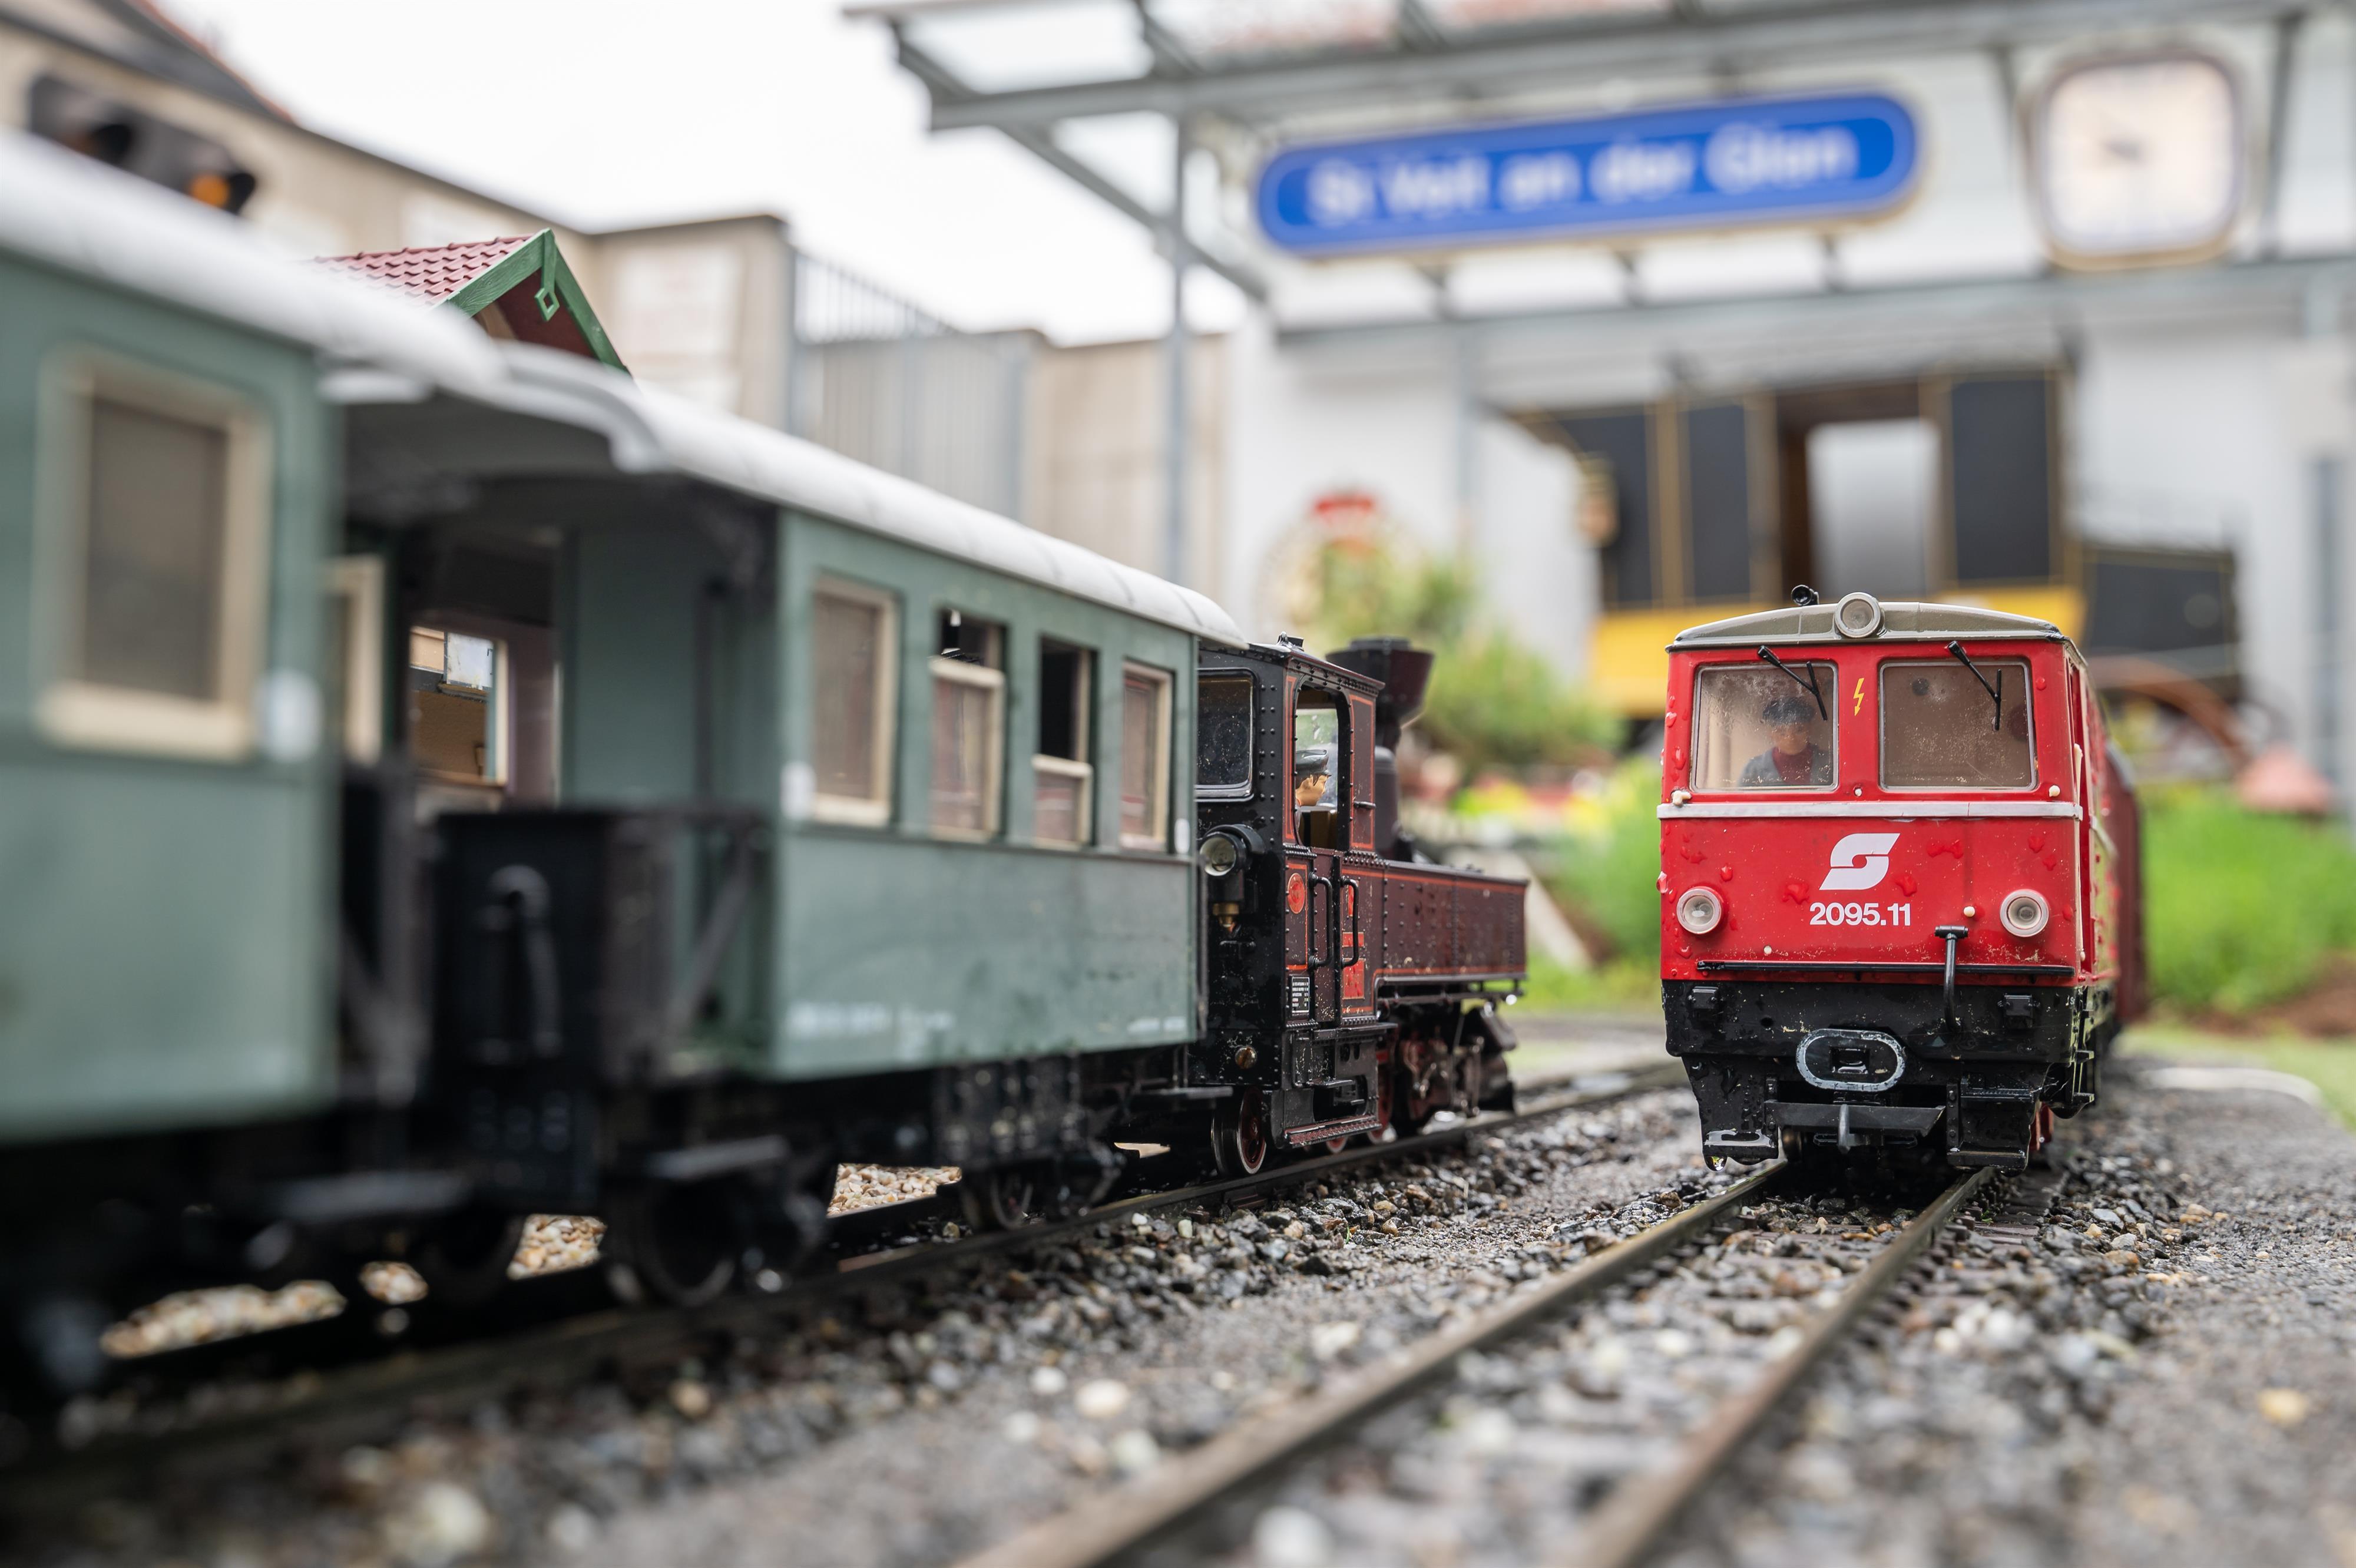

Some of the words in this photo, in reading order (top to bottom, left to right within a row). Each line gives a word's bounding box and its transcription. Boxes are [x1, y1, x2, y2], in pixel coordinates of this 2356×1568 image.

[1501, 153, 1579, 207] an
[1592, 138, 1694, 201] der
[1809, 902, 1911, 926] 2095.11
